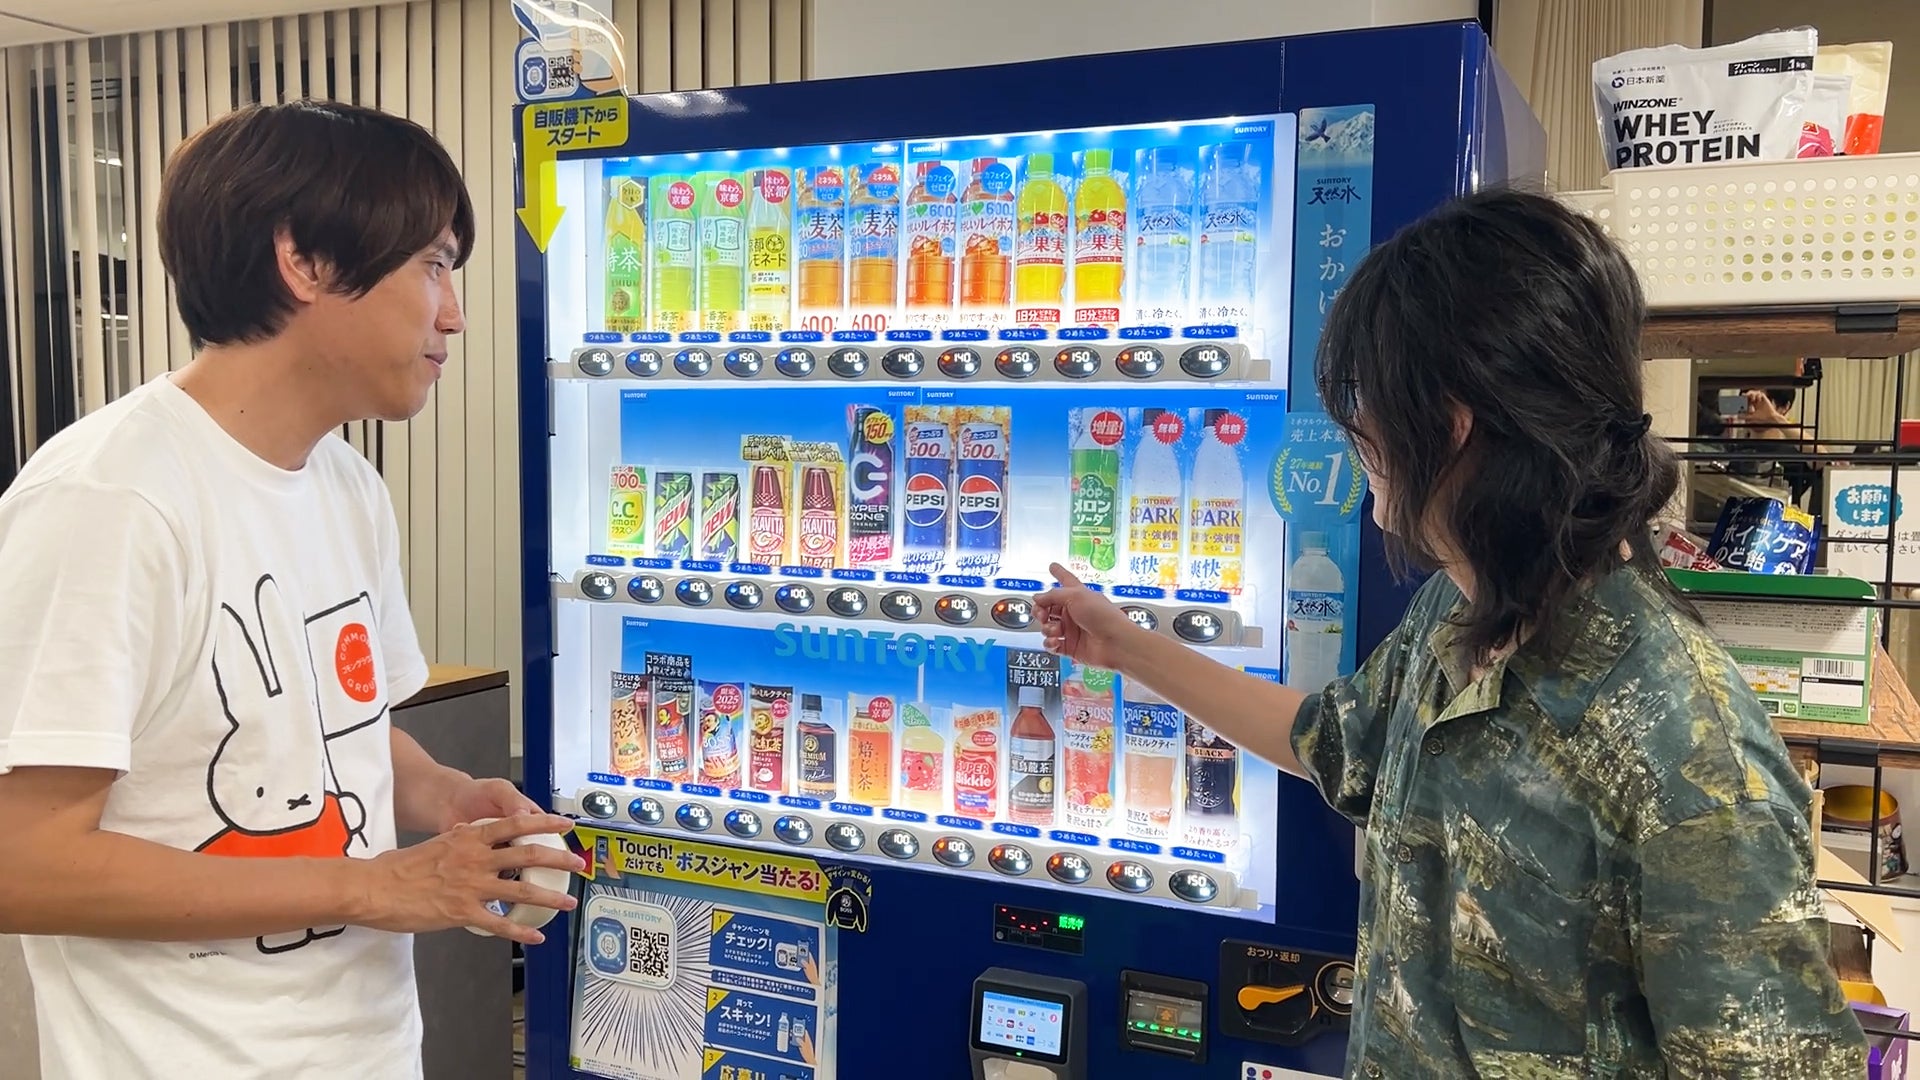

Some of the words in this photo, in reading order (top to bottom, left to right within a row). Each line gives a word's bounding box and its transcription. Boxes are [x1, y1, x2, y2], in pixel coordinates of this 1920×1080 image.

[1626, 74, 1665, 86] 日本新薬
[1613, 97, 1678, 114] WINZONE
[534, 105, 619, 129] 自販機下から
[1234, 125, 1268, 135] SUNTORY
[1613, 109, 1716, 144] WHEY
[546, 127, 601, 147] スタート
[1615, 133, 1761, 170] PROTEIN
[817, 176, 838, 185] ミネラル
[872, 173, 893, 181] ミネラル
[1316, 176, 1352, 186] SUNTORY
[1307, 184, 1362, 206] 天然水
[1141, 213, 1182, 232] 天然水
[1206, 209, 1248, 229] 天然水
[592, 352, 607, 363] 160
[639, 352, 655, 363] 100
[688, 352, 704, 363] 100
[738, 352, 755, 362] 150
[790, 351, 806, 362] 100
[843, 351, 860, 362] 100
[897, 351, 915, 362] 140
[953, 352, 971, 363] 140
[1011, 351, 1030, 363] 150
[1071, 351, 1090, 363] 150
[1133, 350, 1152, 362] 100
[1198, 350, 1218, 361] 100
[888, 390, 915, 398] SUNTORY
[926, 391, 954, 399] SUNTORY
[1245, 393, 1279, 401] SUNTORY
[1090, 420, 1124, 437] 増量!
[1157, 422, 1179, 435] 無糖
[1219, 422, 1242, 435] 無糖
[909, 442, 941, 457] 500
[962, 443, 995, 458] 500
[1079, 487, 1104, 498] POP
[1073, 498, 1112, 514] メロン
[1076, 513, 1109, 526] ソーダ
[1852, 507, 1885, 524] します
[1720, 524, 1808, 560] ボイスケア
[1714, 546, 1767, 571] のど飴
[594, 577, 609, 587] 100
[641, 579, 657, 590] 100
[689, 582, 706, 593] 100
[739, 585, 755, 596] 100
[789, 588, 806, 599] 100
[842, 592, 859, 602] 180
[895, 595, 913, 606] 100
[951, 599, 968, 610] 100
[1007, 603, 1026, 614] 140
[1293, 598, 1336, 618] 天然水
[1127, 610, 1147, 622] 100
[1191, 615, 1211, 627] 100
[774, 622, 997, 673] SUNTORY
[1015, 651, 1051, 669] 本気の
[715, 695, 740, 705] 2025
[1089, 705, 1114, 723] BOSS
[1151, 710, 1178, 728] BOSS
[1194, 748, 1224, 758] BLACK
[956, 760, 990, 775] SUPER
[595, 796, 610, 806] 100
[641, 802, 657, 813] 100
[689, 807, 705, 818] 100
[738, 813, 754, 824] 100
[788, 819, 805, 831] 140
[840, 825, 857, 837] 100
[893, 833, 910, 845] 100
[616, 836, 673, 861] Touch!
[947, 841, 966, 853] 100
[1004, 848, 1022, 861] 150
[624, 858, 665, 874] だけでも
[1063, 857, 1082, 869] 150
[676, 852, 821, 891] ボスジャン当たる!
[1124, 865, 1143, 879] 160
[1187, 874, 1207, 887] 150
[598, 905, 621, 917] Touch!
[623, 909, 663, 924] SUNTORY
[1058, 915, 1084, 931] 販売中
[731, 923, 770, 936] キャンペーンを
[725, 931, 773, 952] チェック!
[1246, 946, 1301, 964] おつり・返却
[736, 998, 753, 1009] 買って
[720, 1005, 771, 1028] スキャン!
